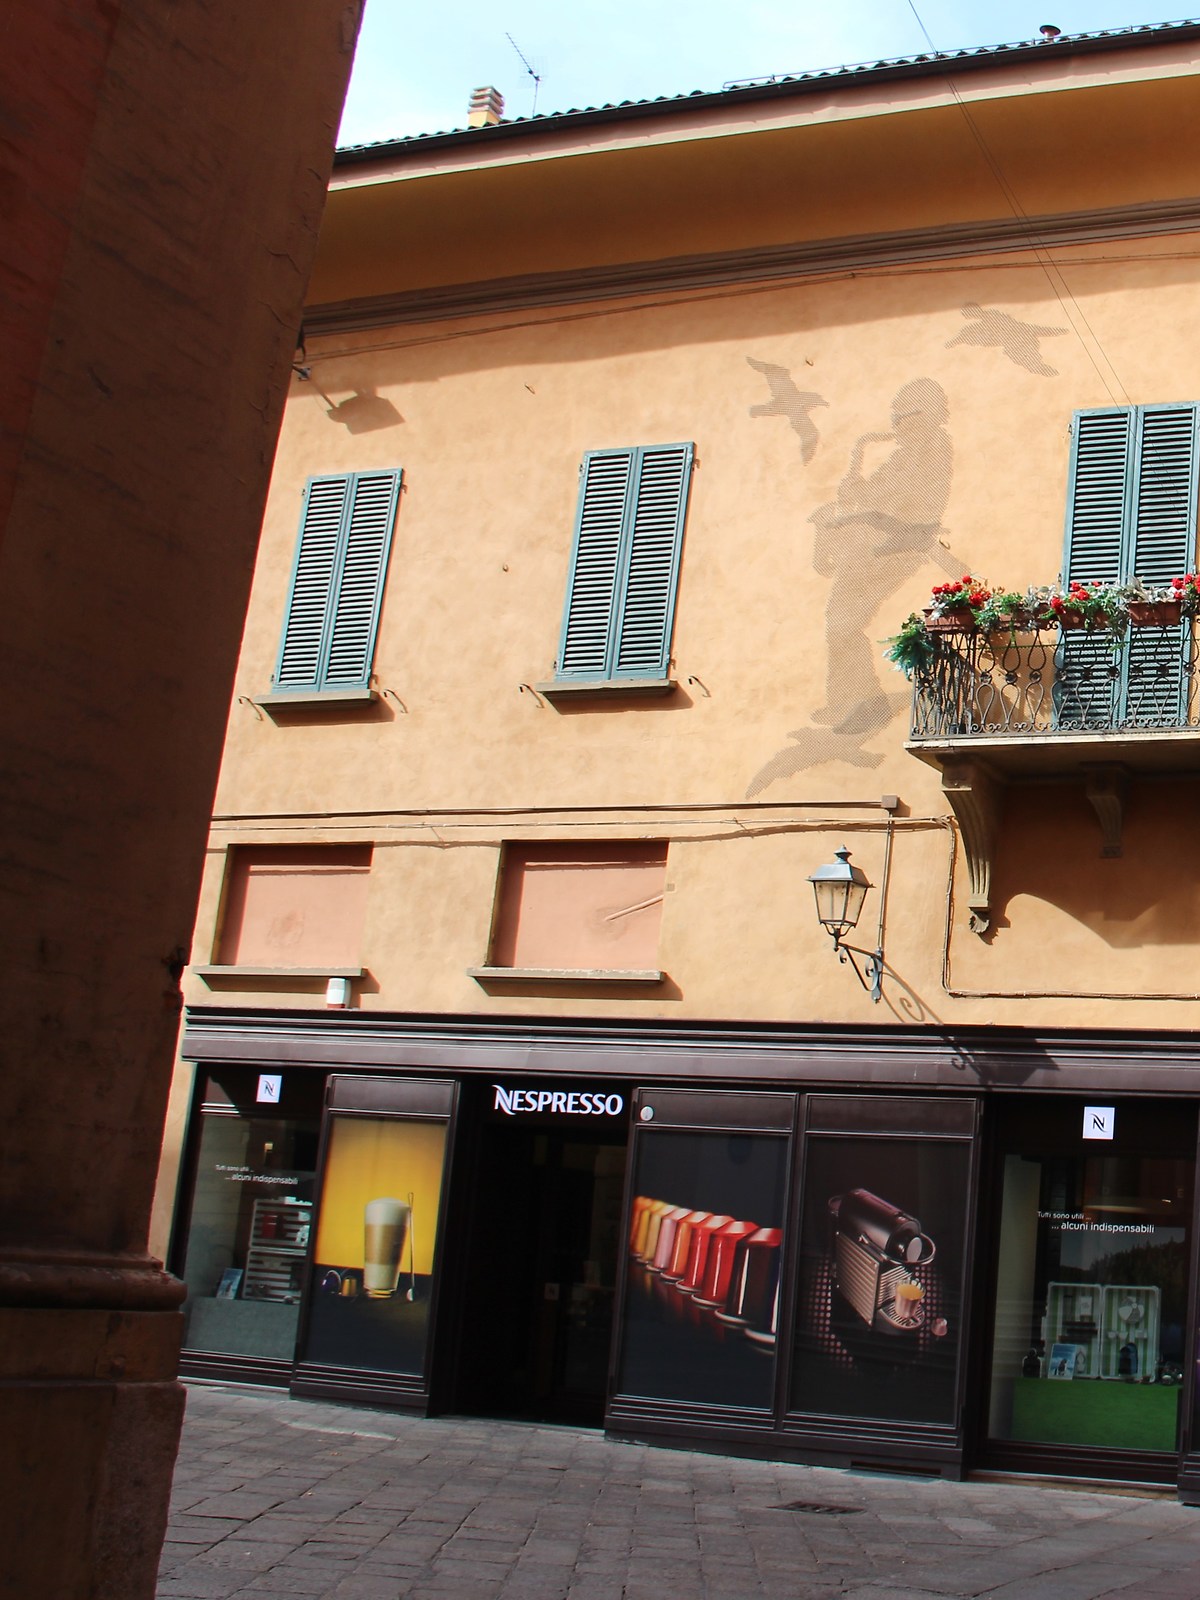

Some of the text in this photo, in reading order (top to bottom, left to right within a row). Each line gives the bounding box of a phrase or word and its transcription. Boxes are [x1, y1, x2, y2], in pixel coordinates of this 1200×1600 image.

[491, 1084, 624, 1116] NESPRESSO
[252, 1175, 299, 1185] indispensabili
[1061, 1221, 1089, 1231] alcuni
[1090, 1222, 1155, 1234] indispensabili
